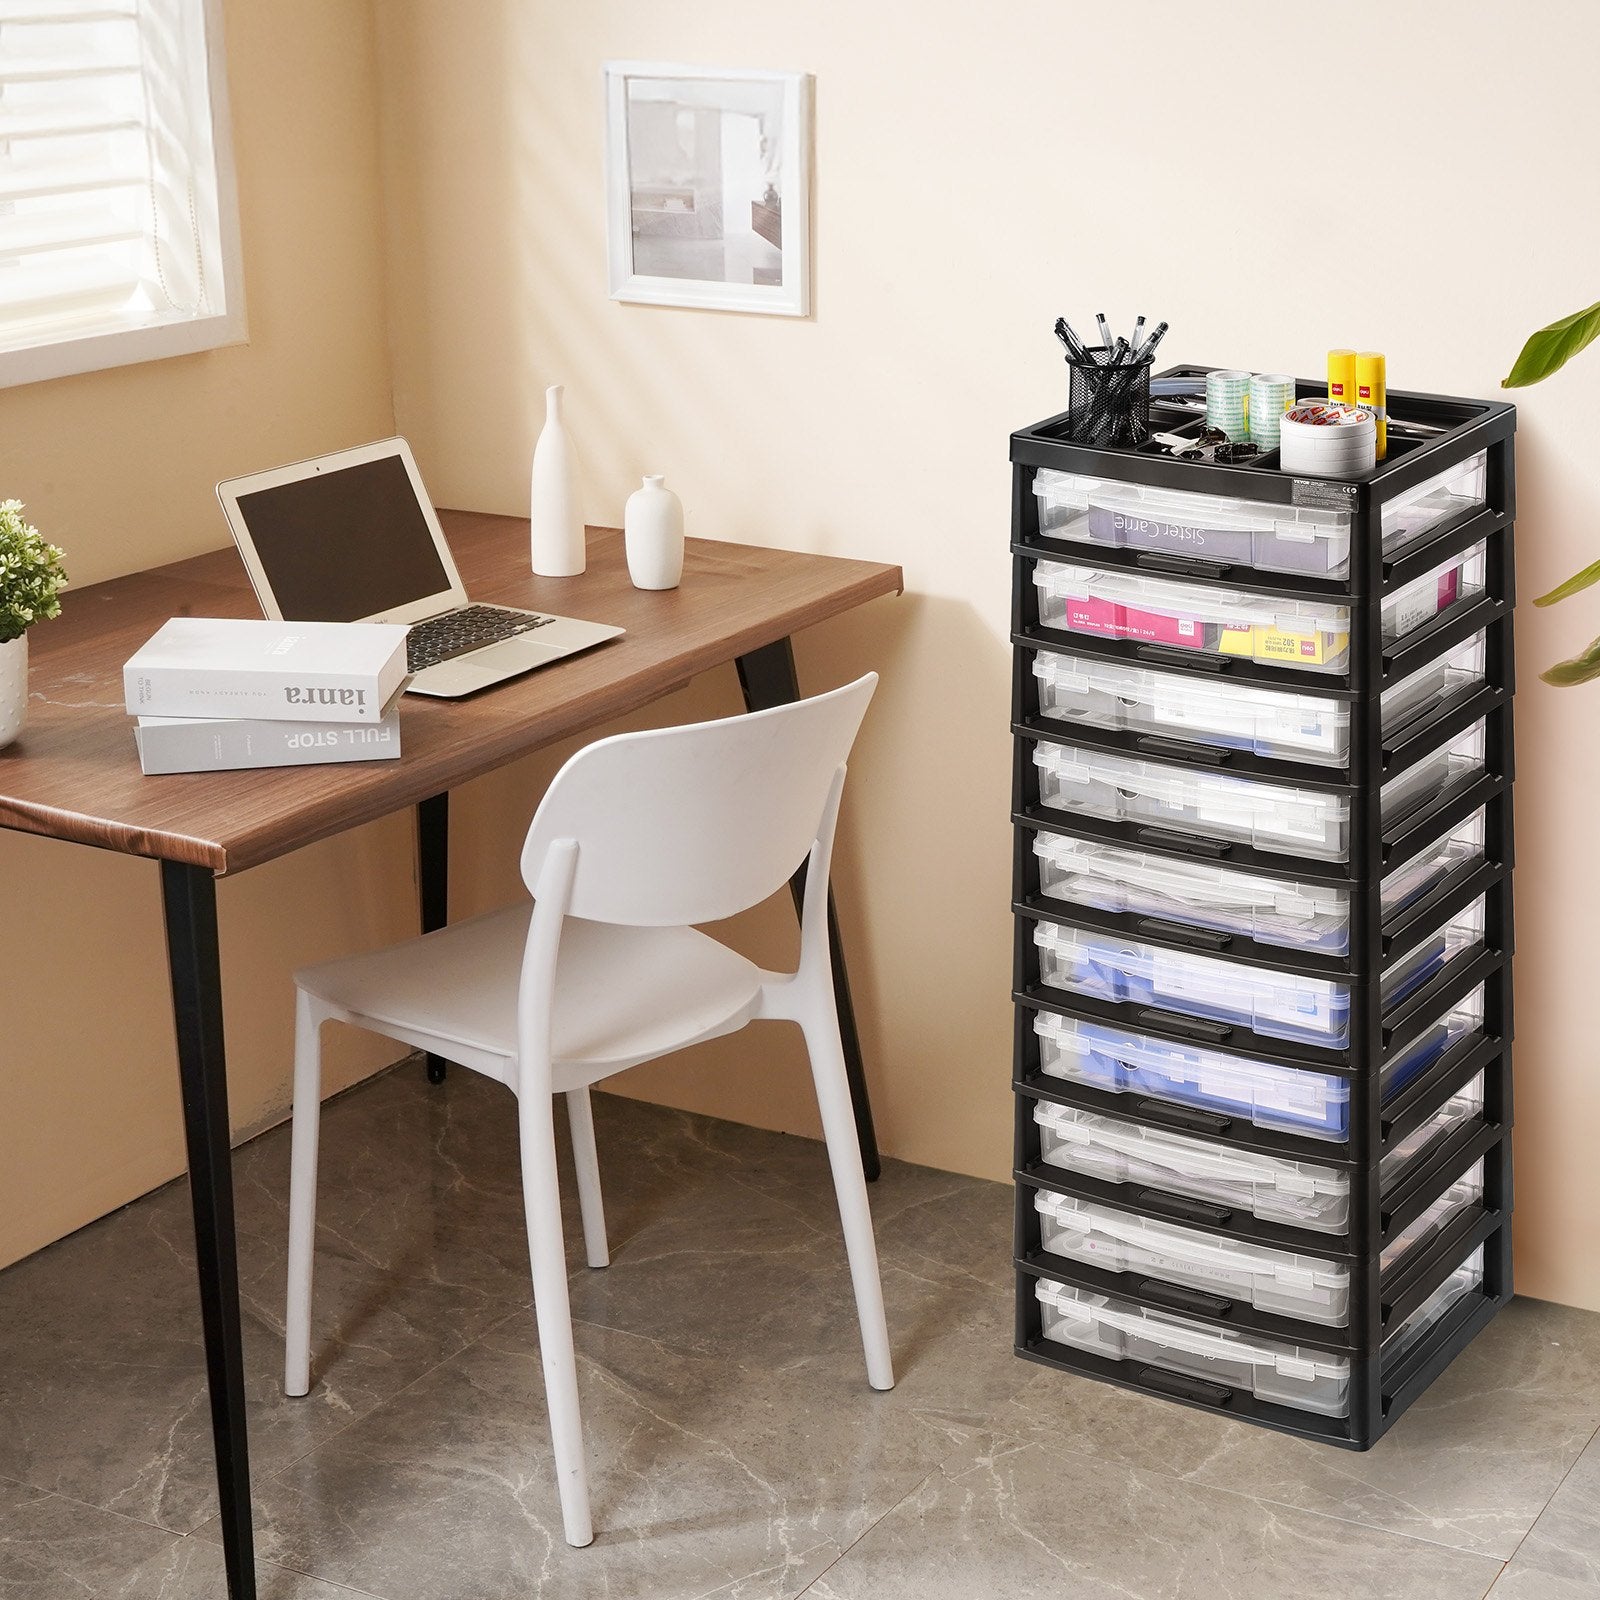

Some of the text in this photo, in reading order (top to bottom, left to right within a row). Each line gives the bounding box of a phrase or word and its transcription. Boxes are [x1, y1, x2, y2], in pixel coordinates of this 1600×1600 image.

[1114, 516, 1206, 545] Sister Carrie
[1282, 638, 1295, 647] 502
[284, 686, 366, 715] ianra
[284, 728, 391, 749] FULL STOP.
